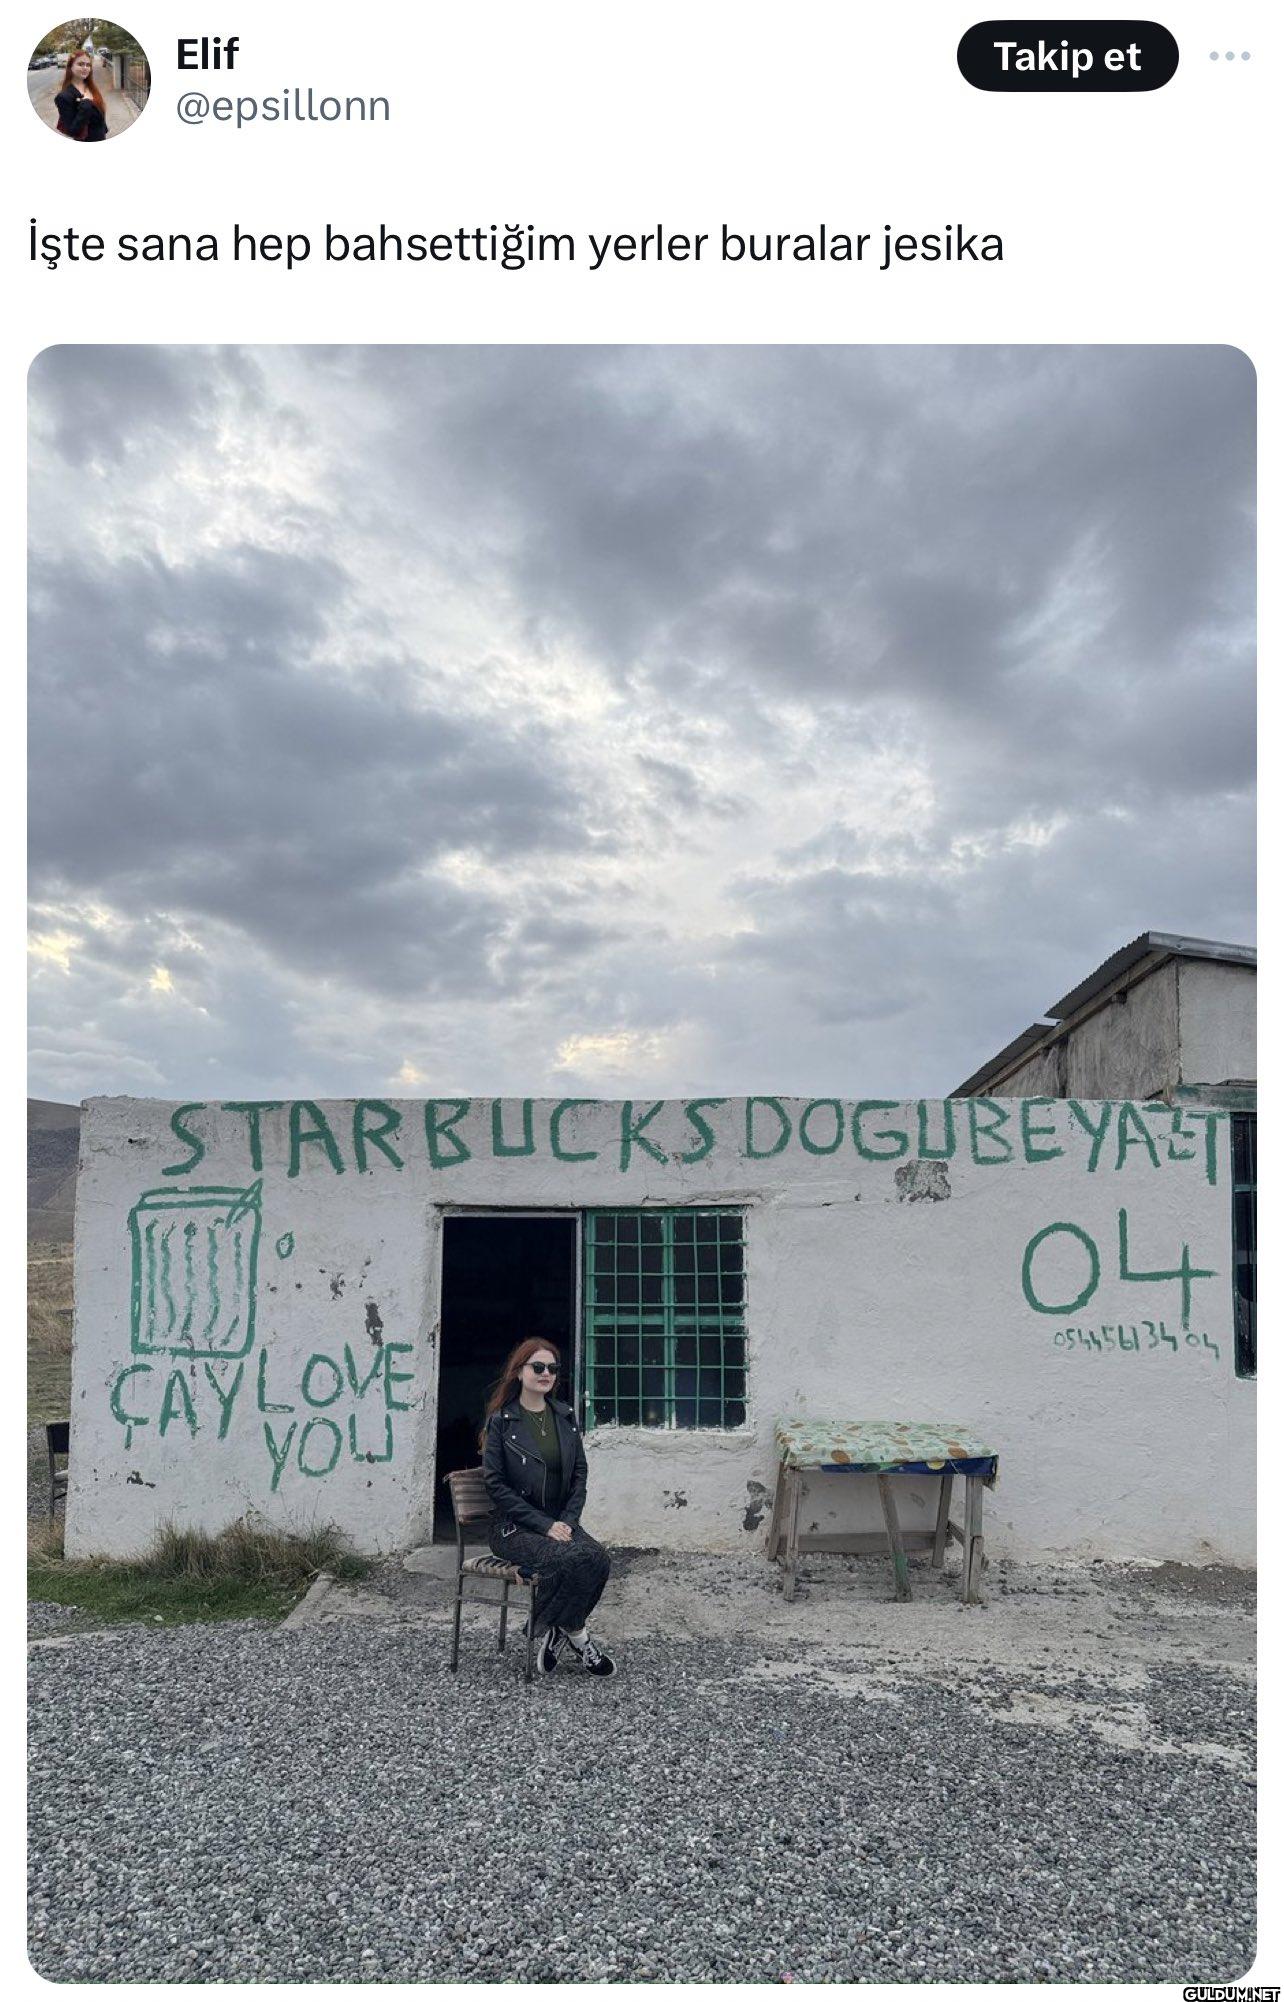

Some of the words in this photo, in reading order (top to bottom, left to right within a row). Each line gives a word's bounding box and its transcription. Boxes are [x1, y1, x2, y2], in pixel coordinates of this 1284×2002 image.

[163, 1098, 728, 1178] STARBUCKS
[1022, 1208, 1218, 1330] 04
[110, 1363, 245, 1450] ÇAY
[258, 1342, 415, 1413] LOVE
[264, 1413, 394, 1492] YOU
